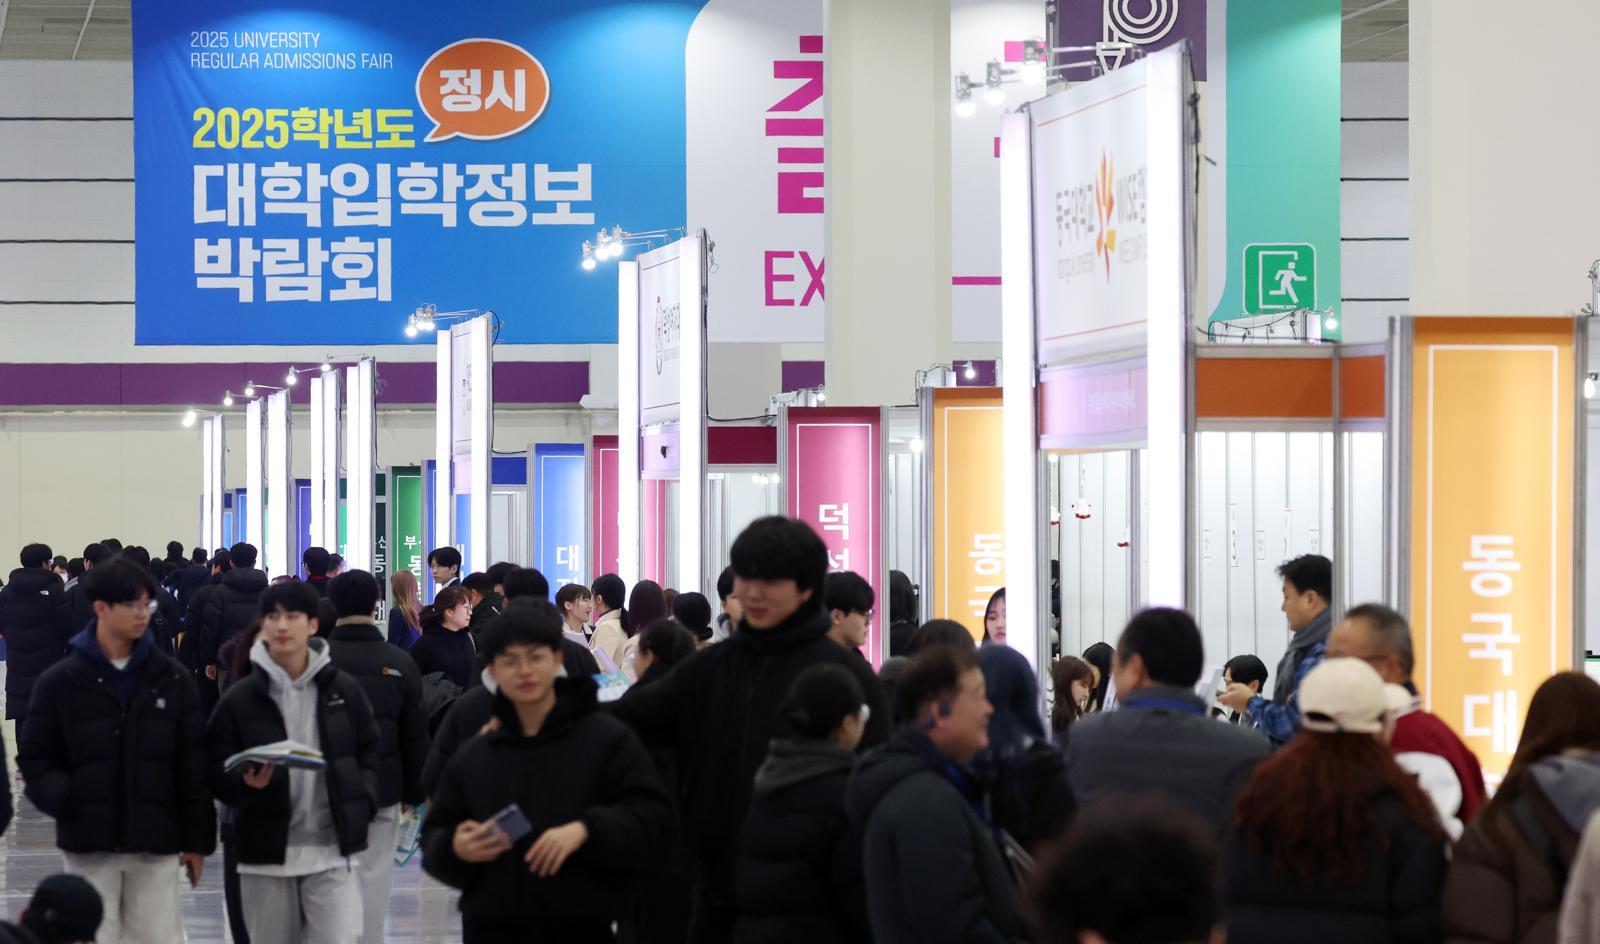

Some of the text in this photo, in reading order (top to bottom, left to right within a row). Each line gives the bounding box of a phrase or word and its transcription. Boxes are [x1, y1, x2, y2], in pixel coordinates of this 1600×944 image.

[190, 31, 321, 48] 2025 UNIVERSITY
[190, 52, 393, 69] REGULAR ADMISSIONS FAIR
[439, 68, 526, 112] 정시
[192, 106, 415, 149] 2025학년도
[193, 162, 596, 228] 대학입학정보
[194, 236, 393, 303] 박람회
[1462, 534, 1522, 785] 동국대
